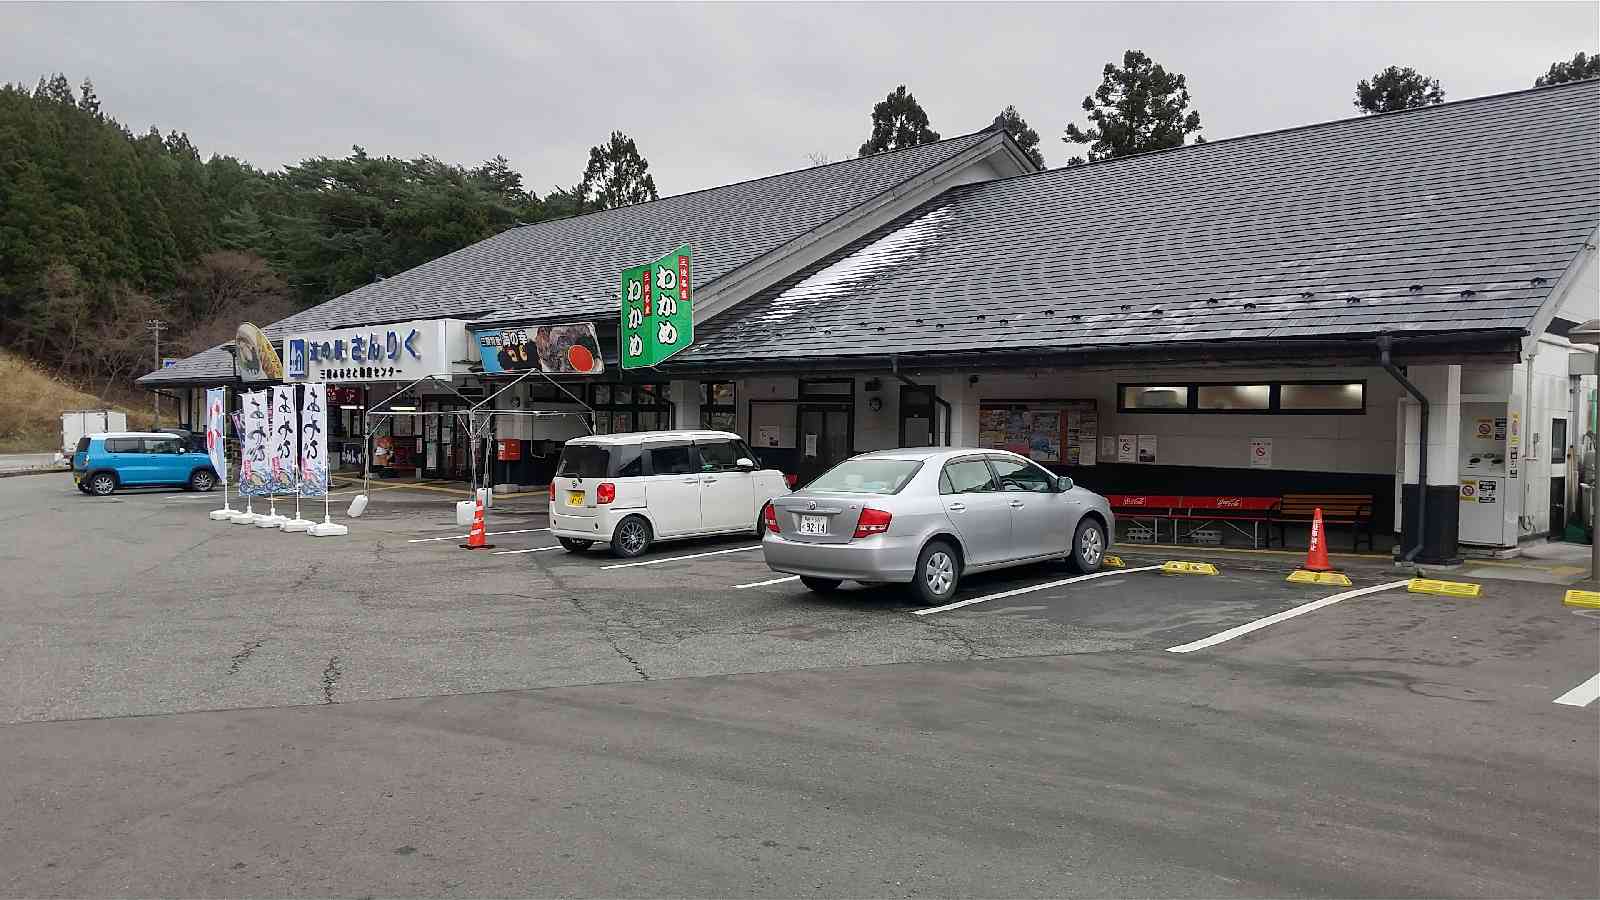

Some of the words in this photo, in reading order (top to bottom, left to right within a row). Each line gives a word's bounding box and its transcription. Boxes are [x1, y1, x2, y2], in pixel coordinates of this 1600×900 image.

[628, 279, 643, 357] わかめ
[656, 265, 678, 345] わかめ
